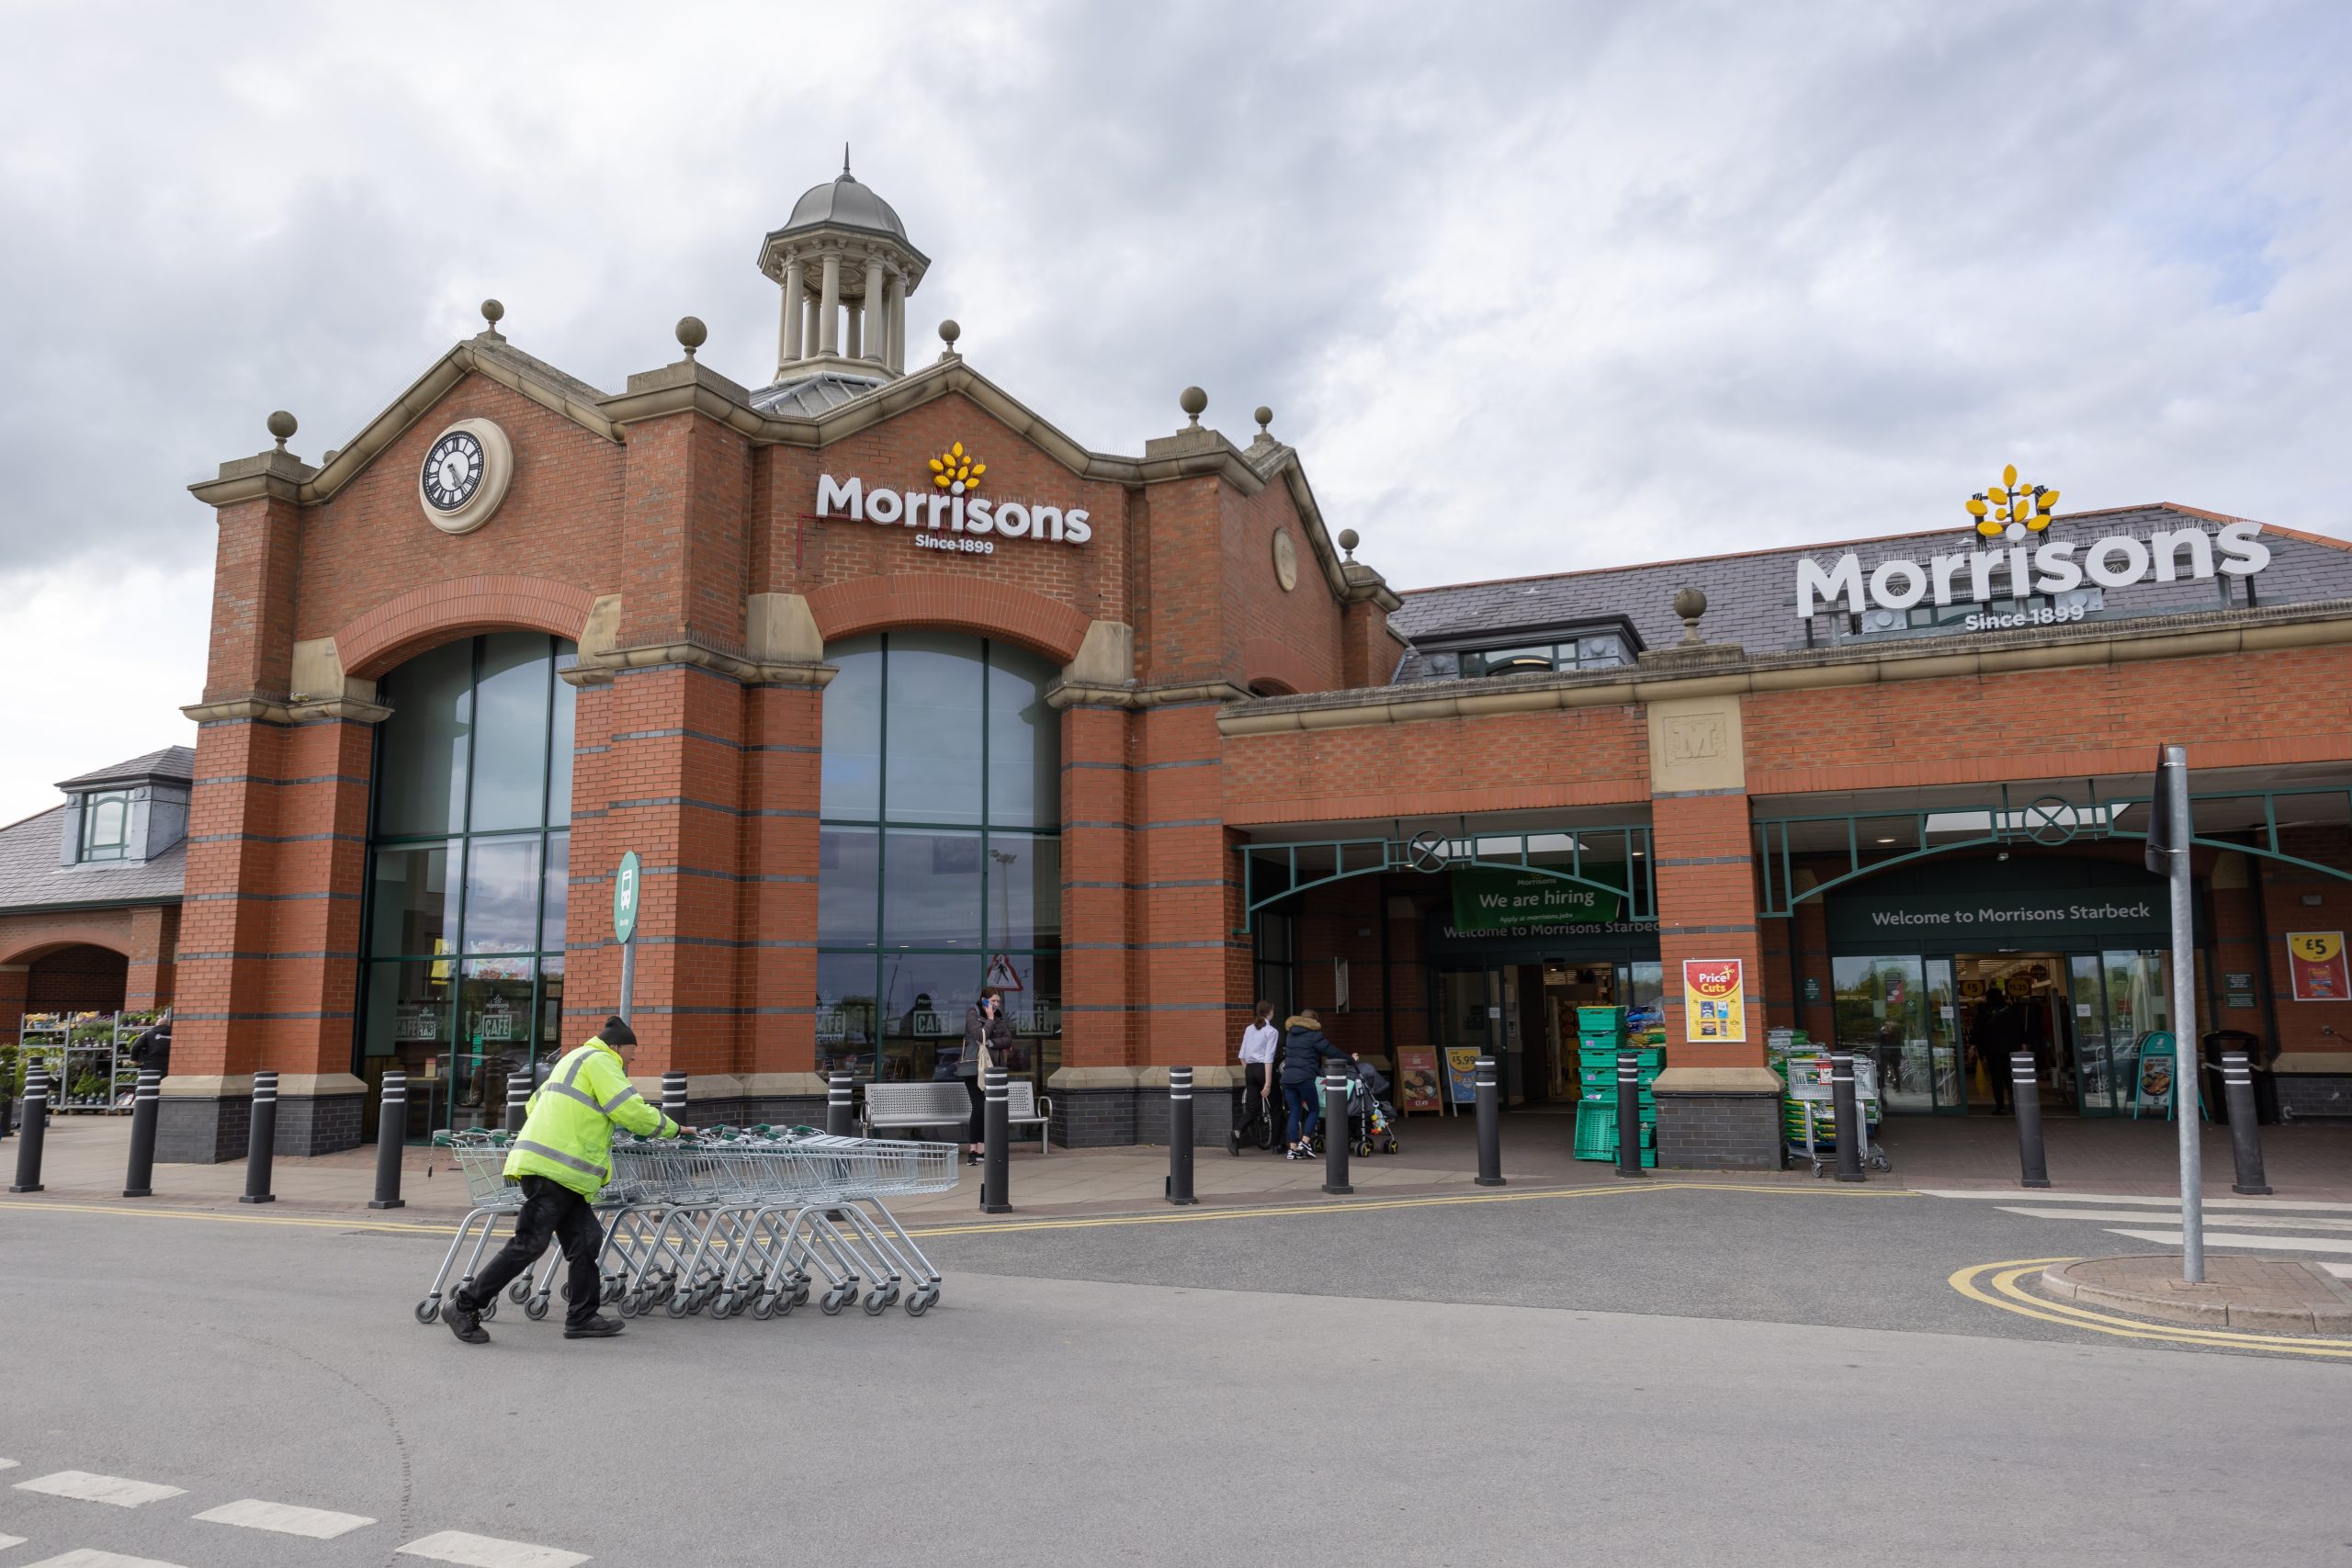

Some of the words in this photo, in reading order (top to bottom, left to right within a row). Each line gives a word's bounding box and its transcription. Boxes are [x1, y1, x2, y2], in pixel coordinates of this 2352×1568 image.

[816, 473, 1091, 544] Morrisons
[915, 534, 956, 551] Since
[958, 538, 993, 554] 1899
[1796, 521, 2271, 618] Morrisons
[1965, 609, 2026, 632] Since
[2030, 604, 2085, 626] 1899
[1517, 877, 1556, 886] Morrisons
[1479, 893, 1508, 908] We
[1513, 894, 1538, 908] are
[1544, 889, 1595, 907] hiring
[1872, 910, 1950, 926] Welcome
[1955, 910, 1973, 923] to
[1978, 907, 2064, 922] Morrisons
[2070, 902, 2151, 919] Starbeck
[1443, 925, 1508, 939] Welcome
[1511, 924, 1527, 935] to
[1531, 922, 1601, 935] Morrisons
[1605, 919, 1660, 933] Starbec
[2306, 939, 2326, 954] £5
[1699, 973, 1727, 982] Price
[1701, 983, 1726, 992] Cuts
[1453, 1055, 1475, 1065] £5.99
